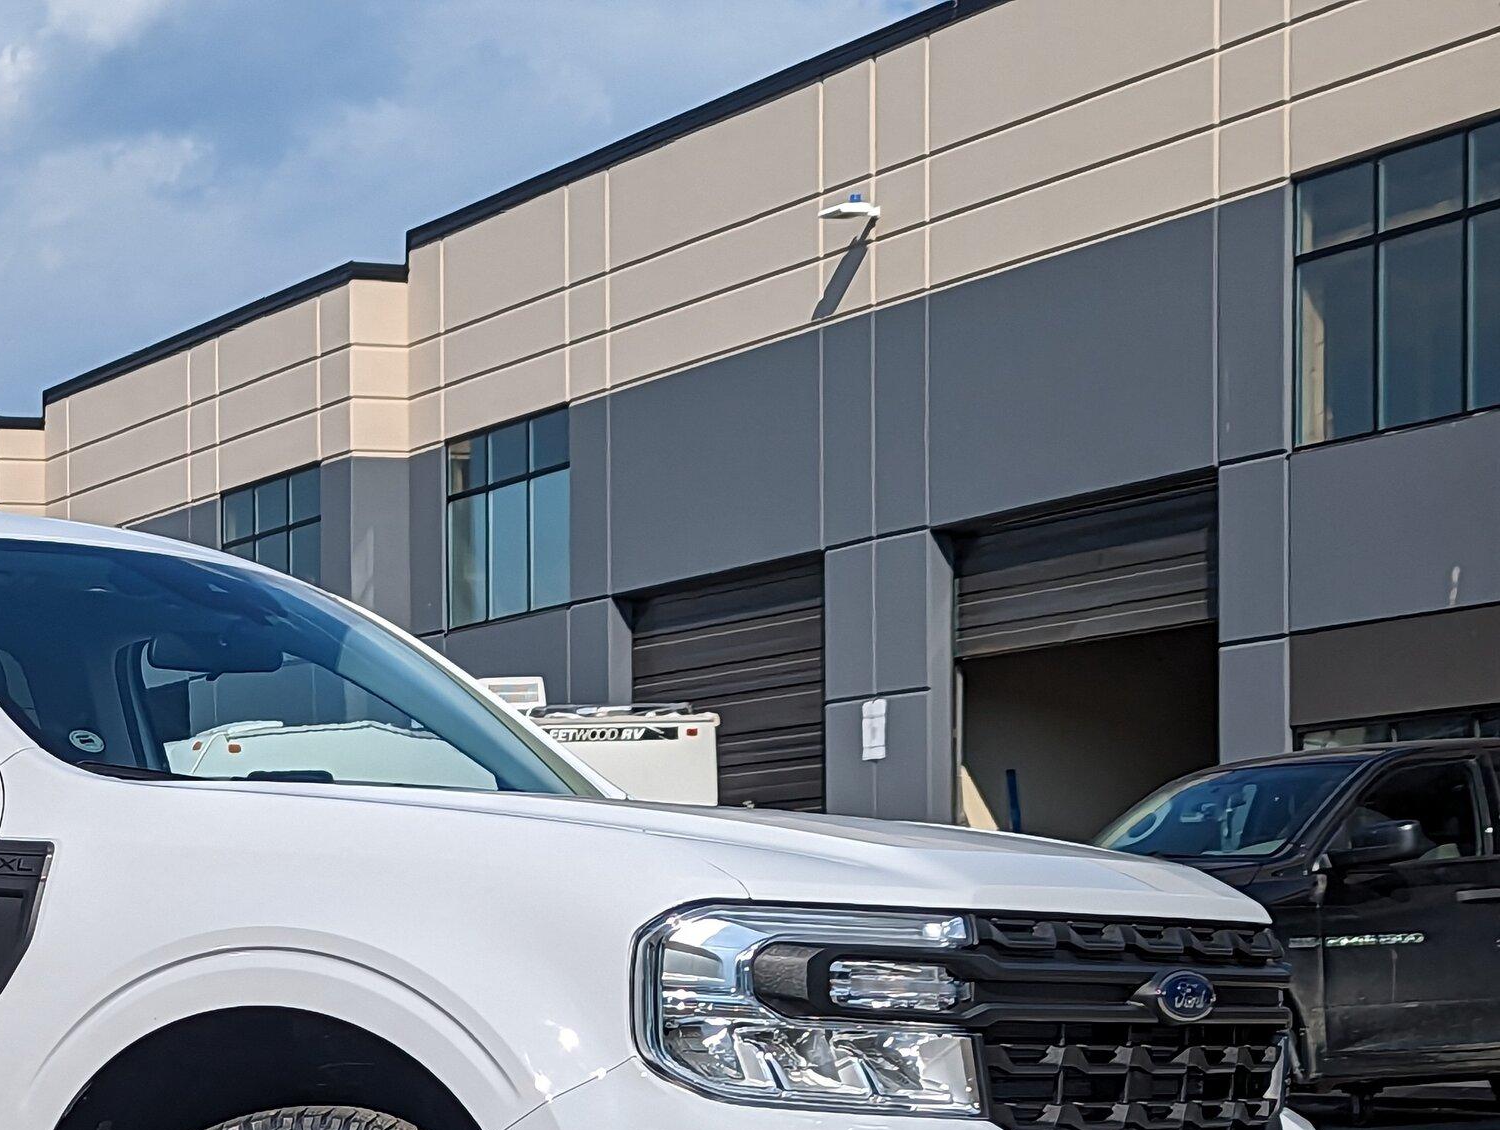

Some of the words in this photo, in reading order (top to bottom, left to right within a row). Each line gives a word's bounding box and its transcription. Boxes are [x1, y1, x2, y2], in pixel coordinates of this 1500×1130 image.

[549, 728, 618, 742] EETWOOD
[621, 728, 646, 740] RV
[1175, 981, 1206, 1009] Ford
